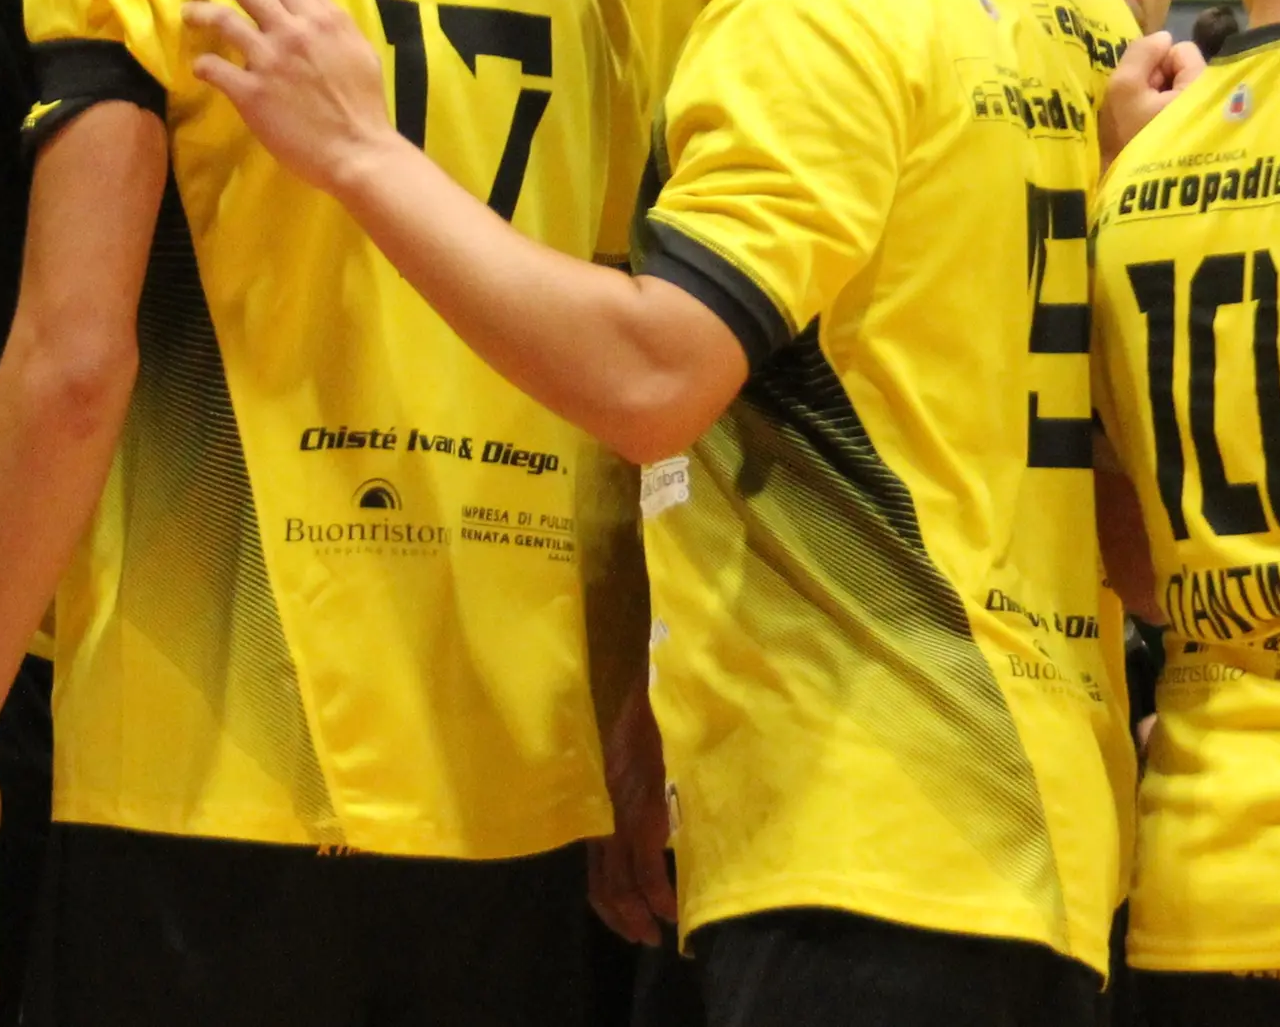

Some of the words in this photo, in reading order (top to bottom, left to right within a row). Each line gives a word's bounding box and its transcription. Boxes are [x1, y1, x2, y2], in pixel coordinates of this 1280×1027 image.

[299, 426, 398, 452] Chisté
[458, 436, 473, 460] &
[480, 441, 560, 475] Diego
[517, 511, 532, 526] DI
[460, 527, 510, 545] RENATA
